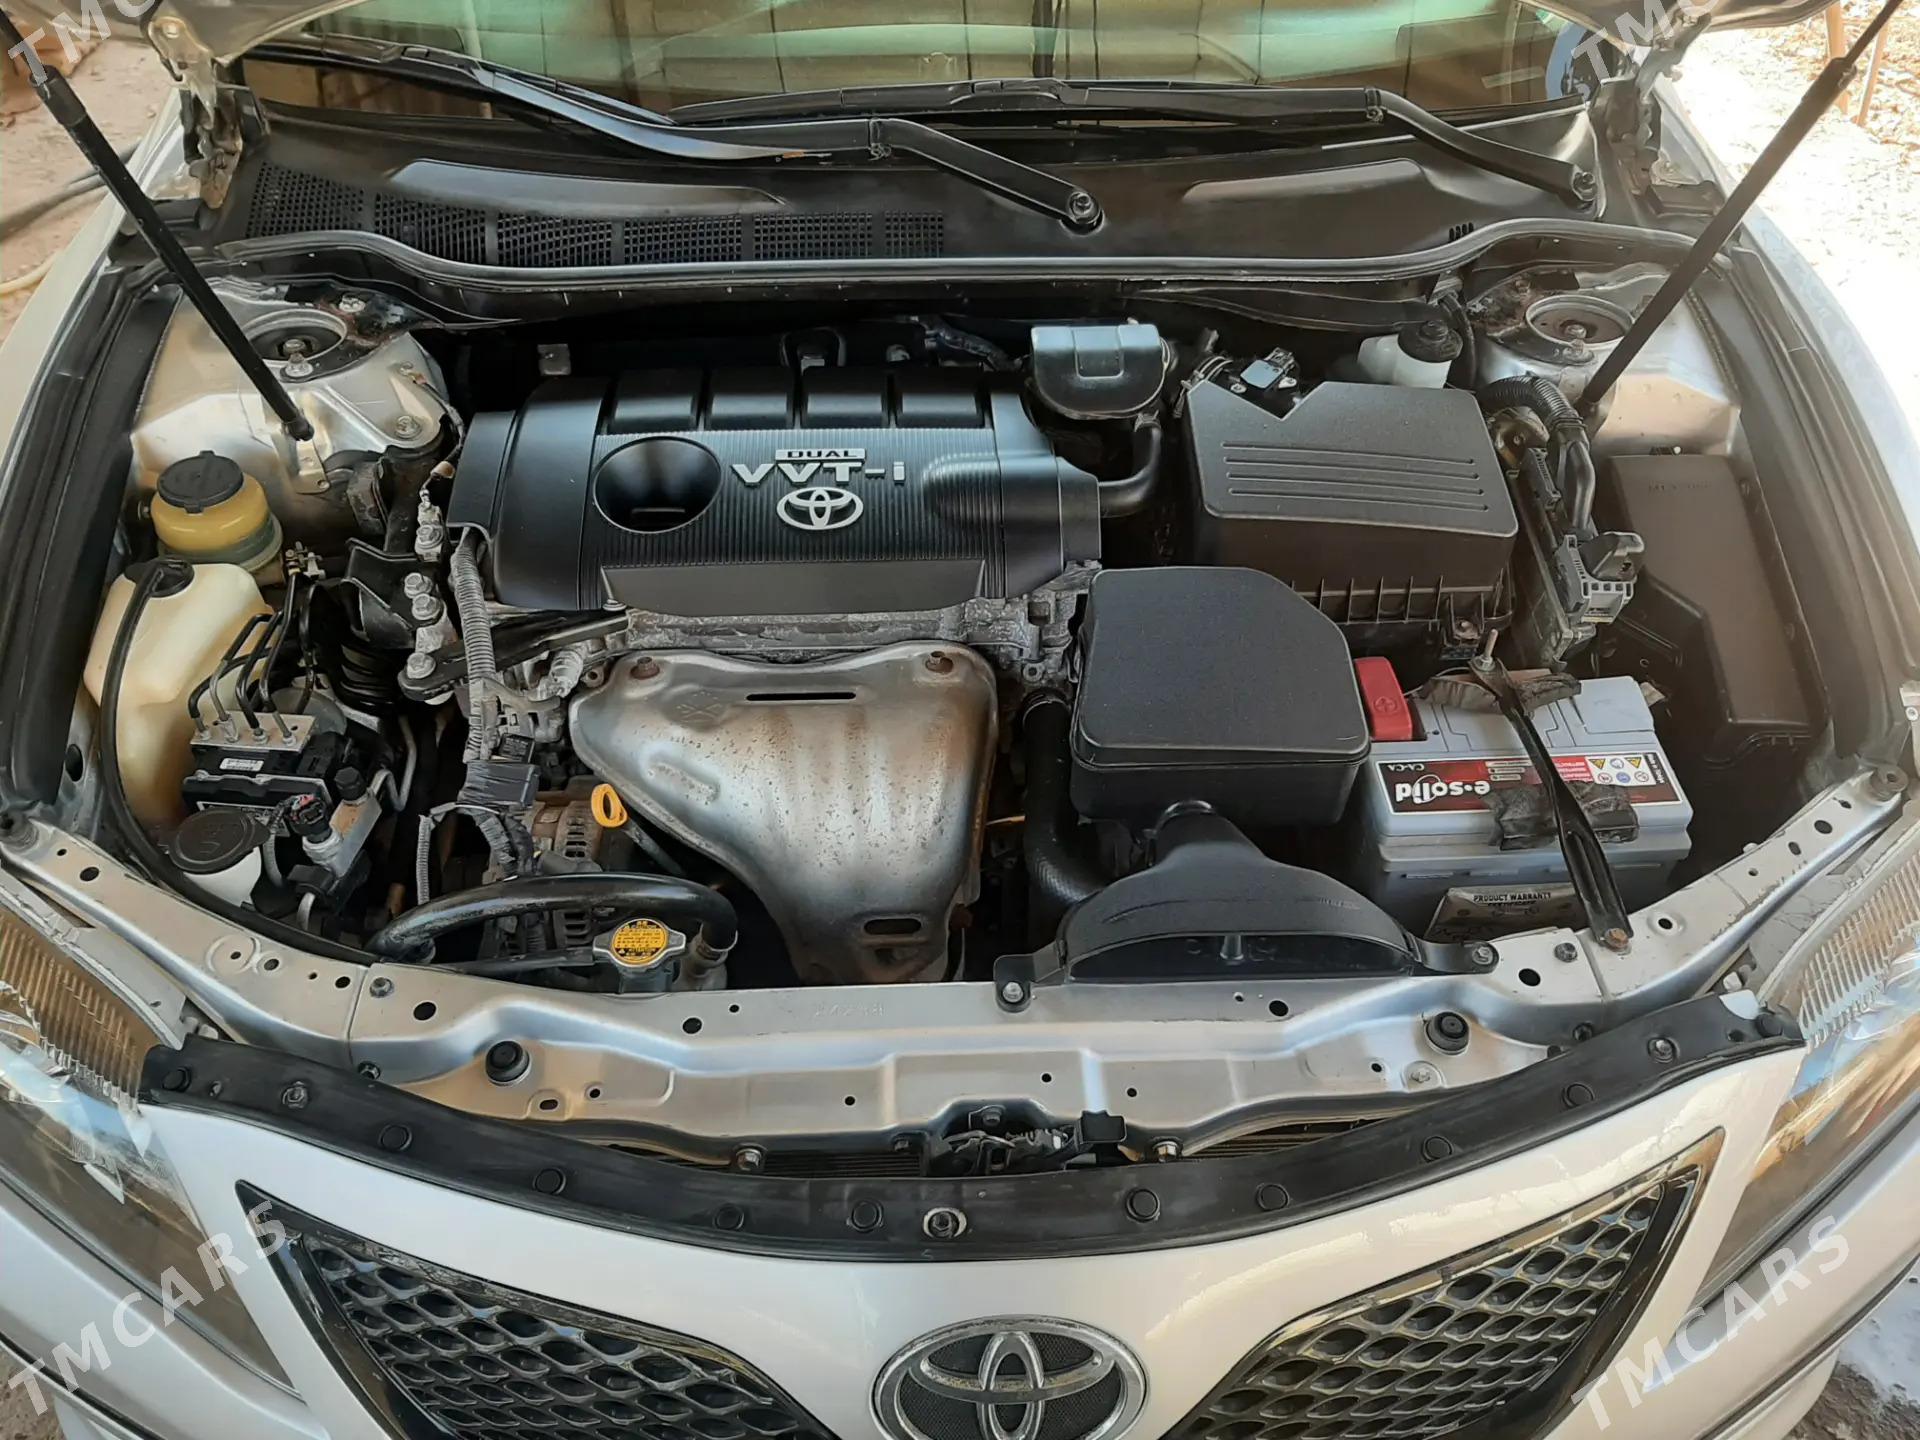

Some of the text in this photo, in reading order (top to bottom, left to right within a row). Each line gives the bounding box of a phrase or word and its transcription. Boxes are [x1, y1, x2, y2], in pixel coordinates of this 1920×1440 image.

[785, 449, 858, 459] DUAL
[1473, 891, 1552, 903] PRODUCT WARRANTY
